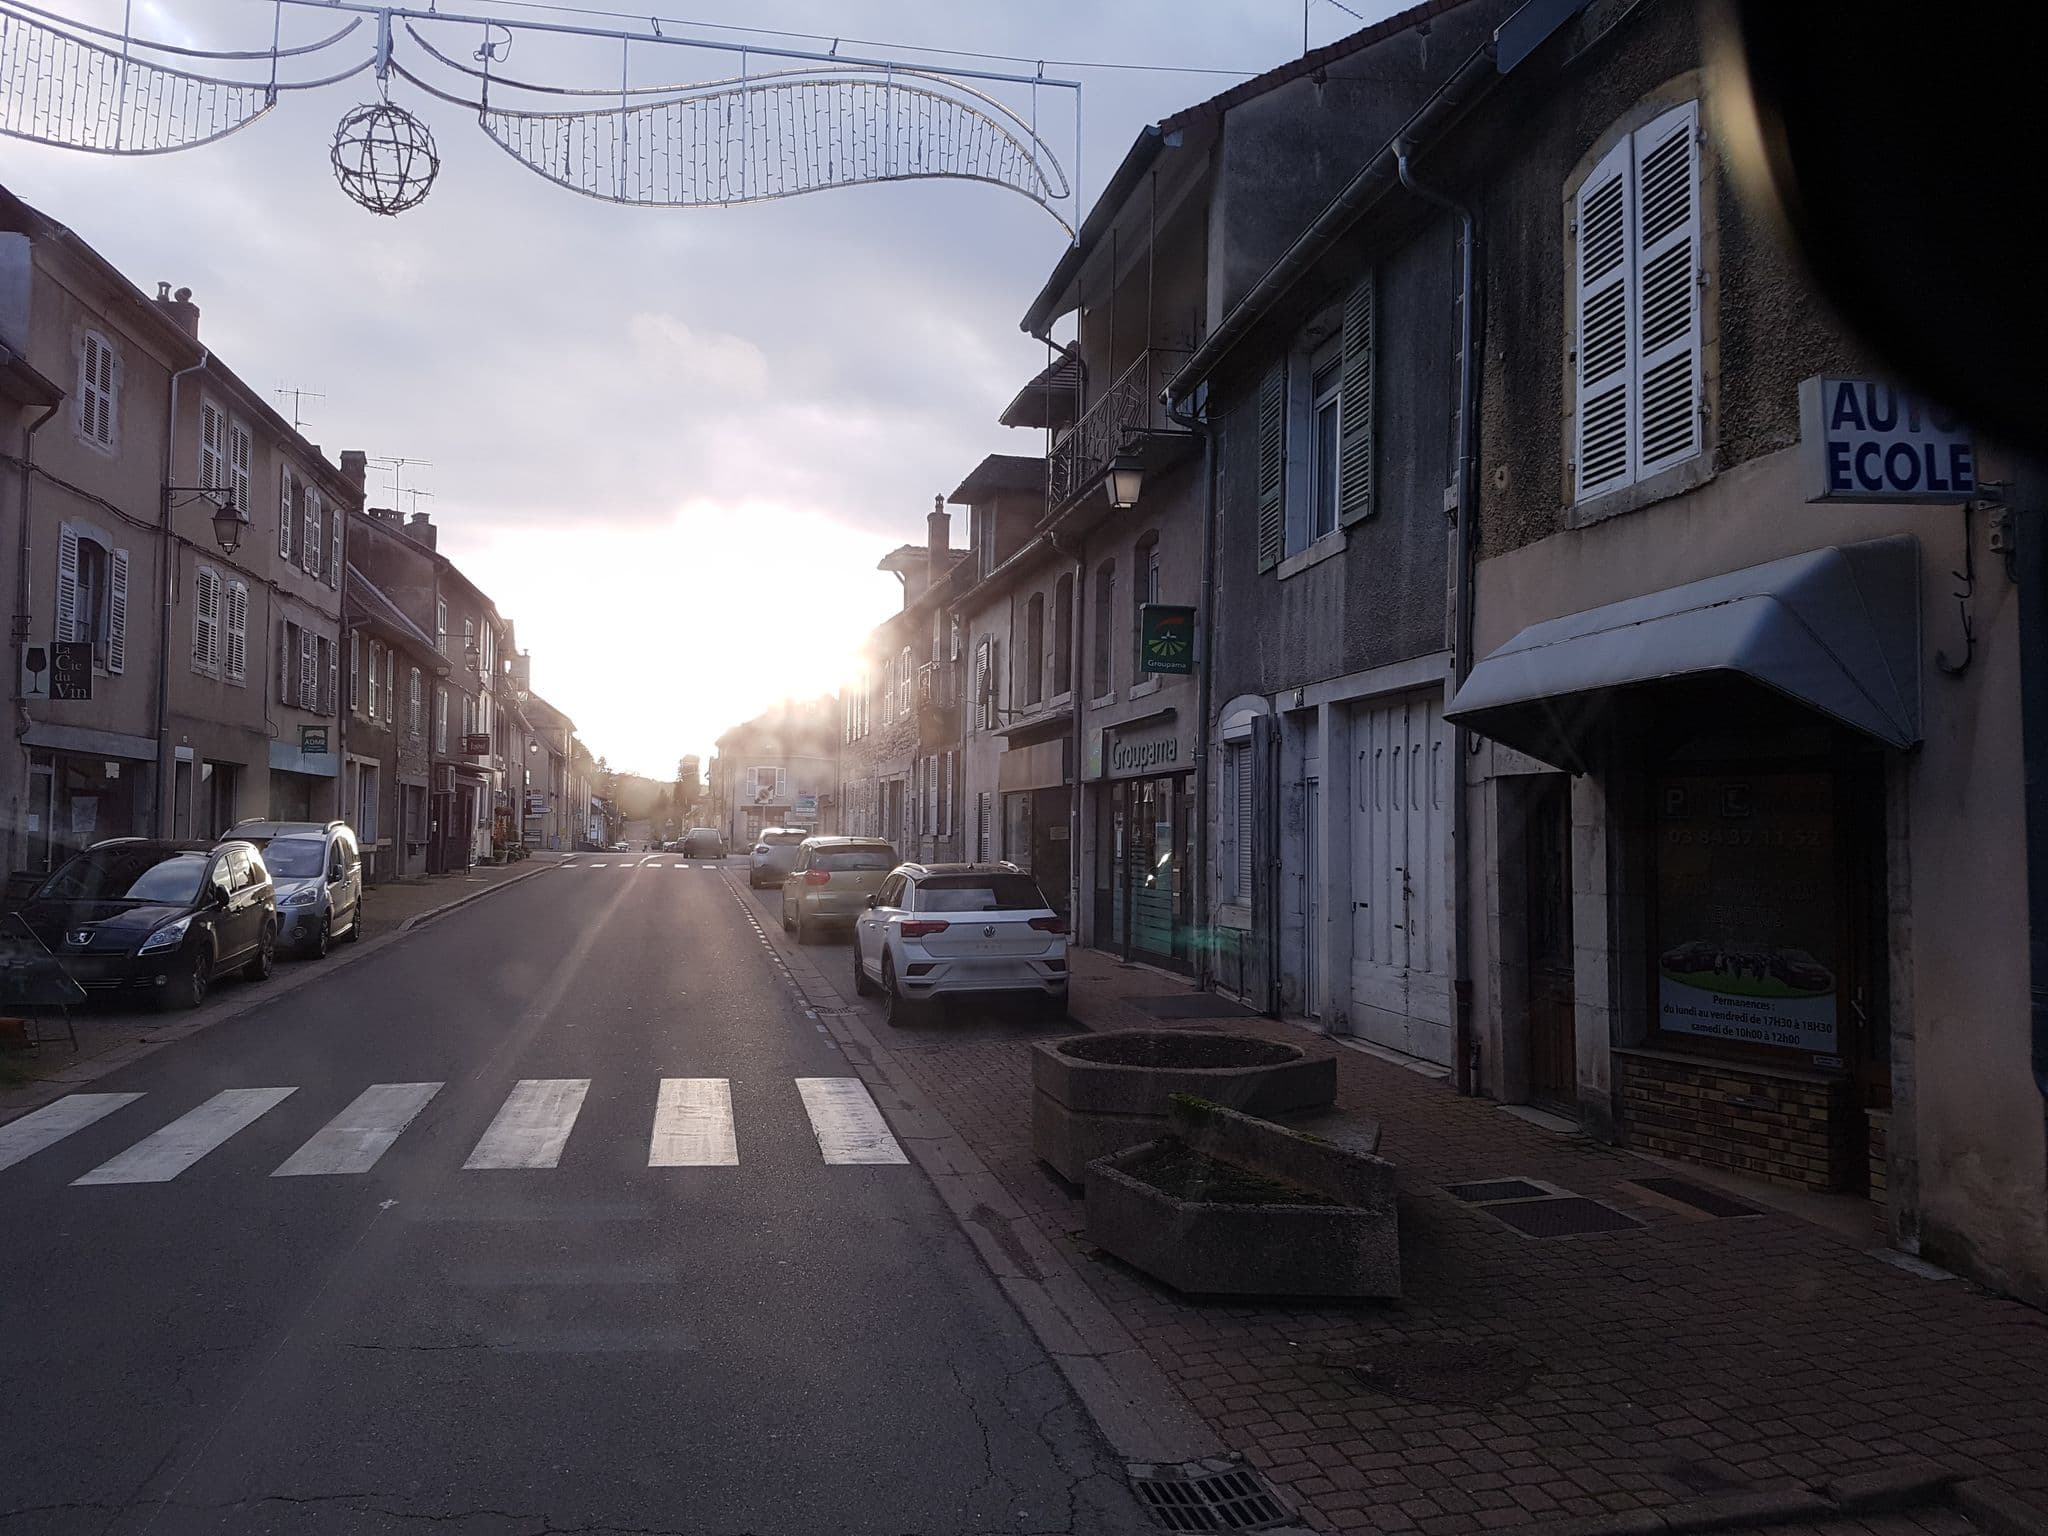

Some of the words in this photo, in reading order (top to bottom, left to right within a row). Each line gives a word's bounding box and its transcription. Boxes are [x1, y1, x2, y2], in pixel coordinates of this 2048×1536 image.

[1828, 442, 1973, 491] ECOLE
[56, 644, 71, 654] La
[56, 655, 82, 671] Cie
[1147, 659, 1187, 669] Groupama
[55, 672, 71, 682] du
[56, 683, 88, 699] Vin
[1113, 739, 1177, 773] Groupama
[1713, 995, 1770, 1011] Permanences
[1663, 1005, 1675, 1014] du
[1675, 1005, 1697, 1016] lundi
[1698, 1009, 1709, 1018] au
[1710, 1010, 1748, 1024] vendredi
[1749, 1014, 1761, 1025] de
[1763, 1016, 1792, 1029] 17H30
[1802, 1020, 1833, 1034] 18H30
[1691, 1023, 1721, 1035] samedi
[1722, 1026, 1734, 1036] de
[1736, 1027, 1763, 1040] 10h00
[1764, 1029, 1770, 1040] à
